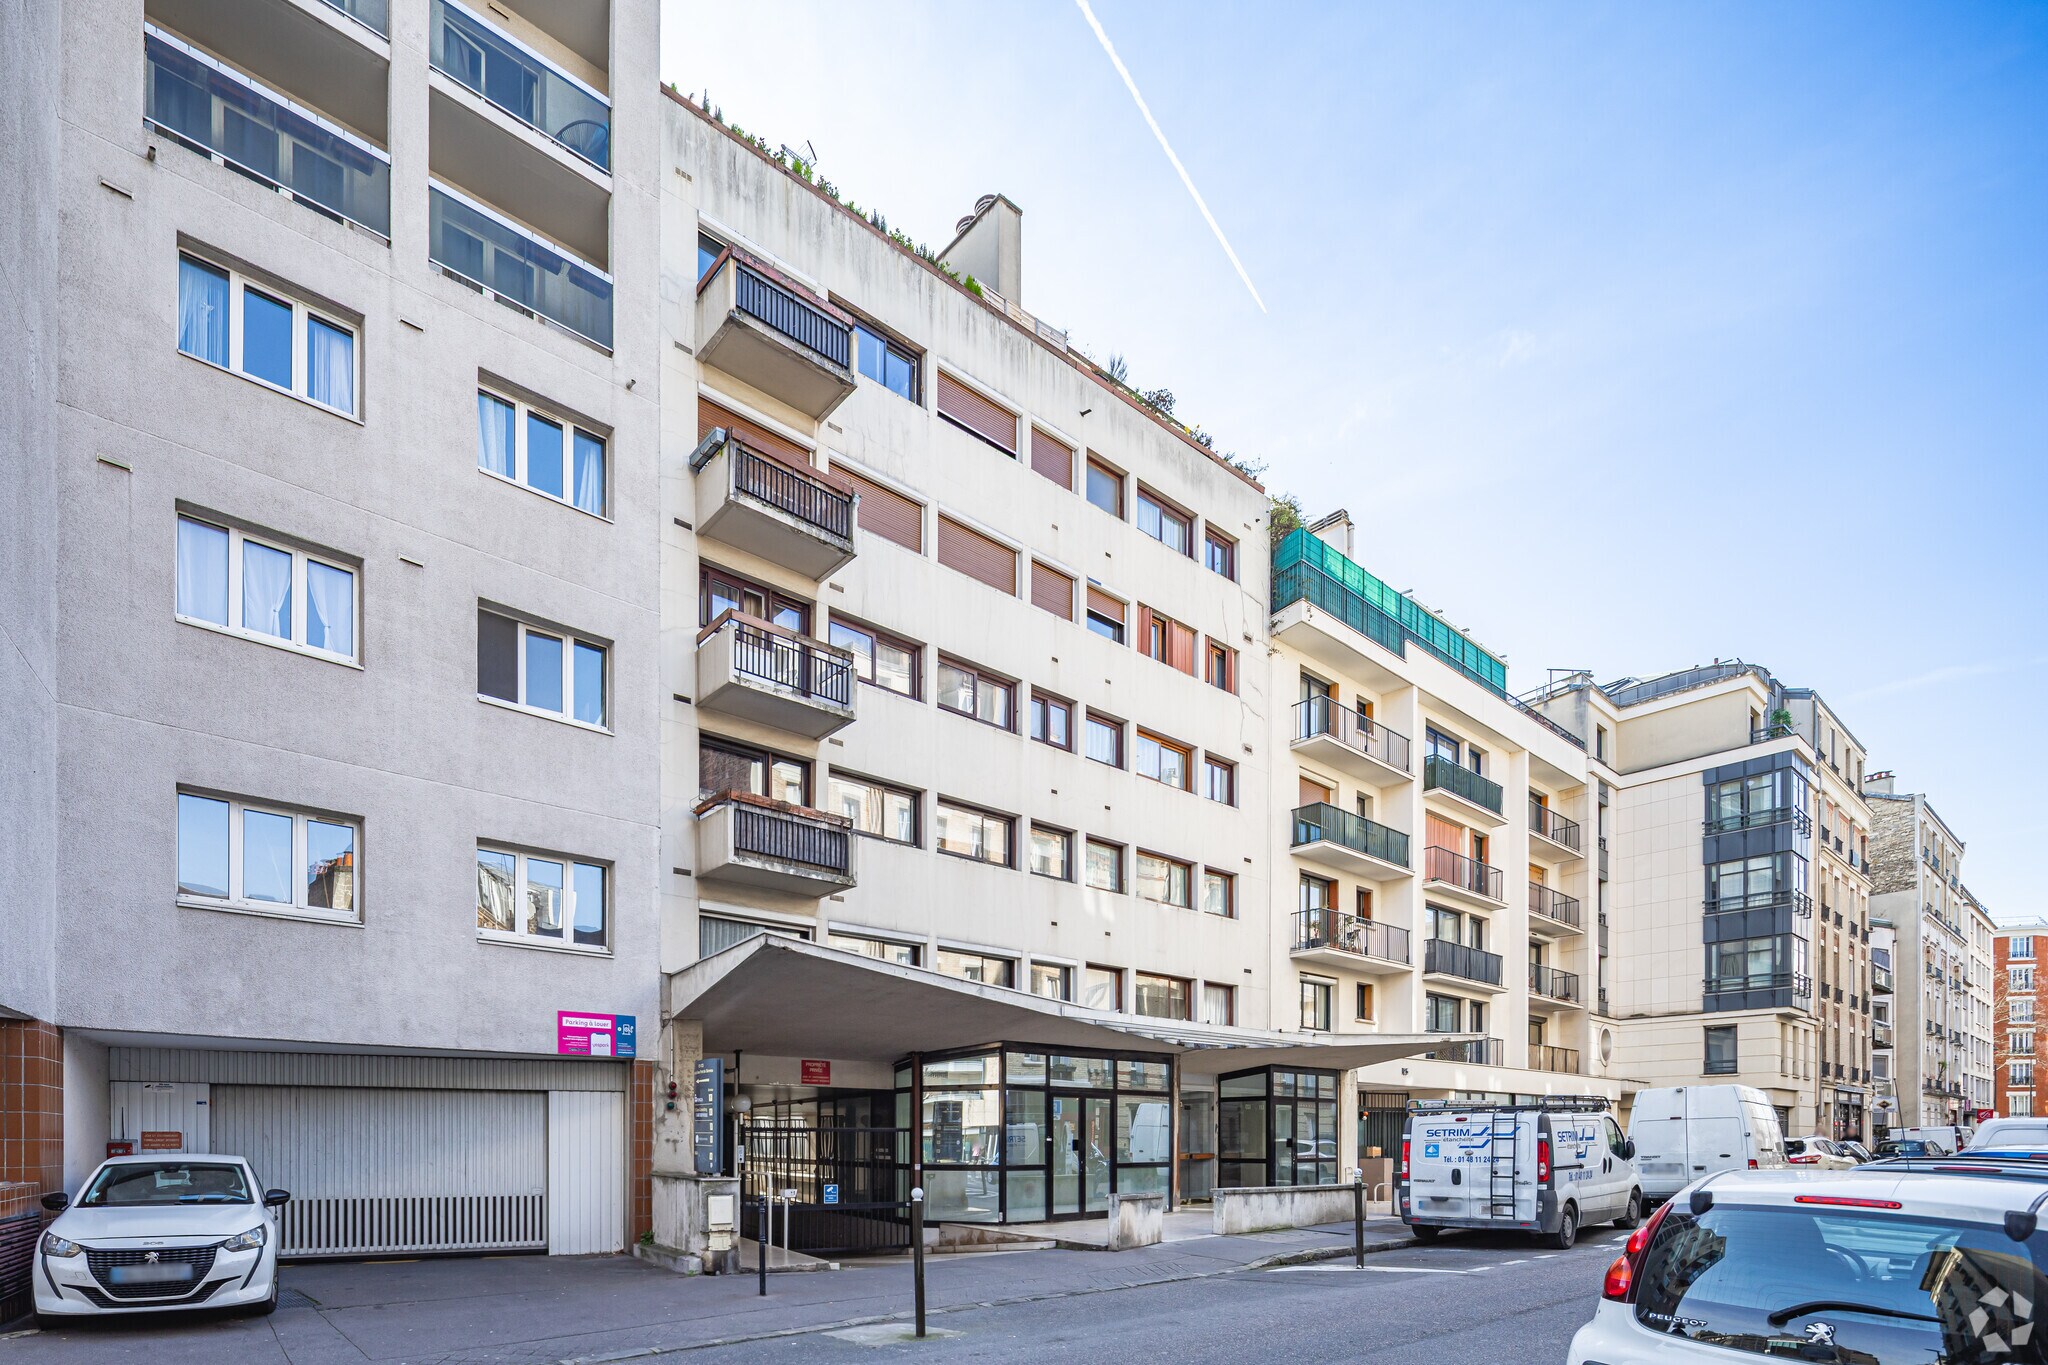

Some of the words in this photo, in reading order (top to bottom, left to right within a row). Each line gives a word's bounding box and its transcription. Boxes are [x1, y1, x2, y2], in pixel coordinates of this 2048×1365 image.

[565, 1019, 588, 1027] Parking
[1426, 1128, 1470, 1138] SETRIM
[1557, 1130, 1578, 1143] SETRIM
[1649, 1313, 1707, 1326] PEUGEOT
